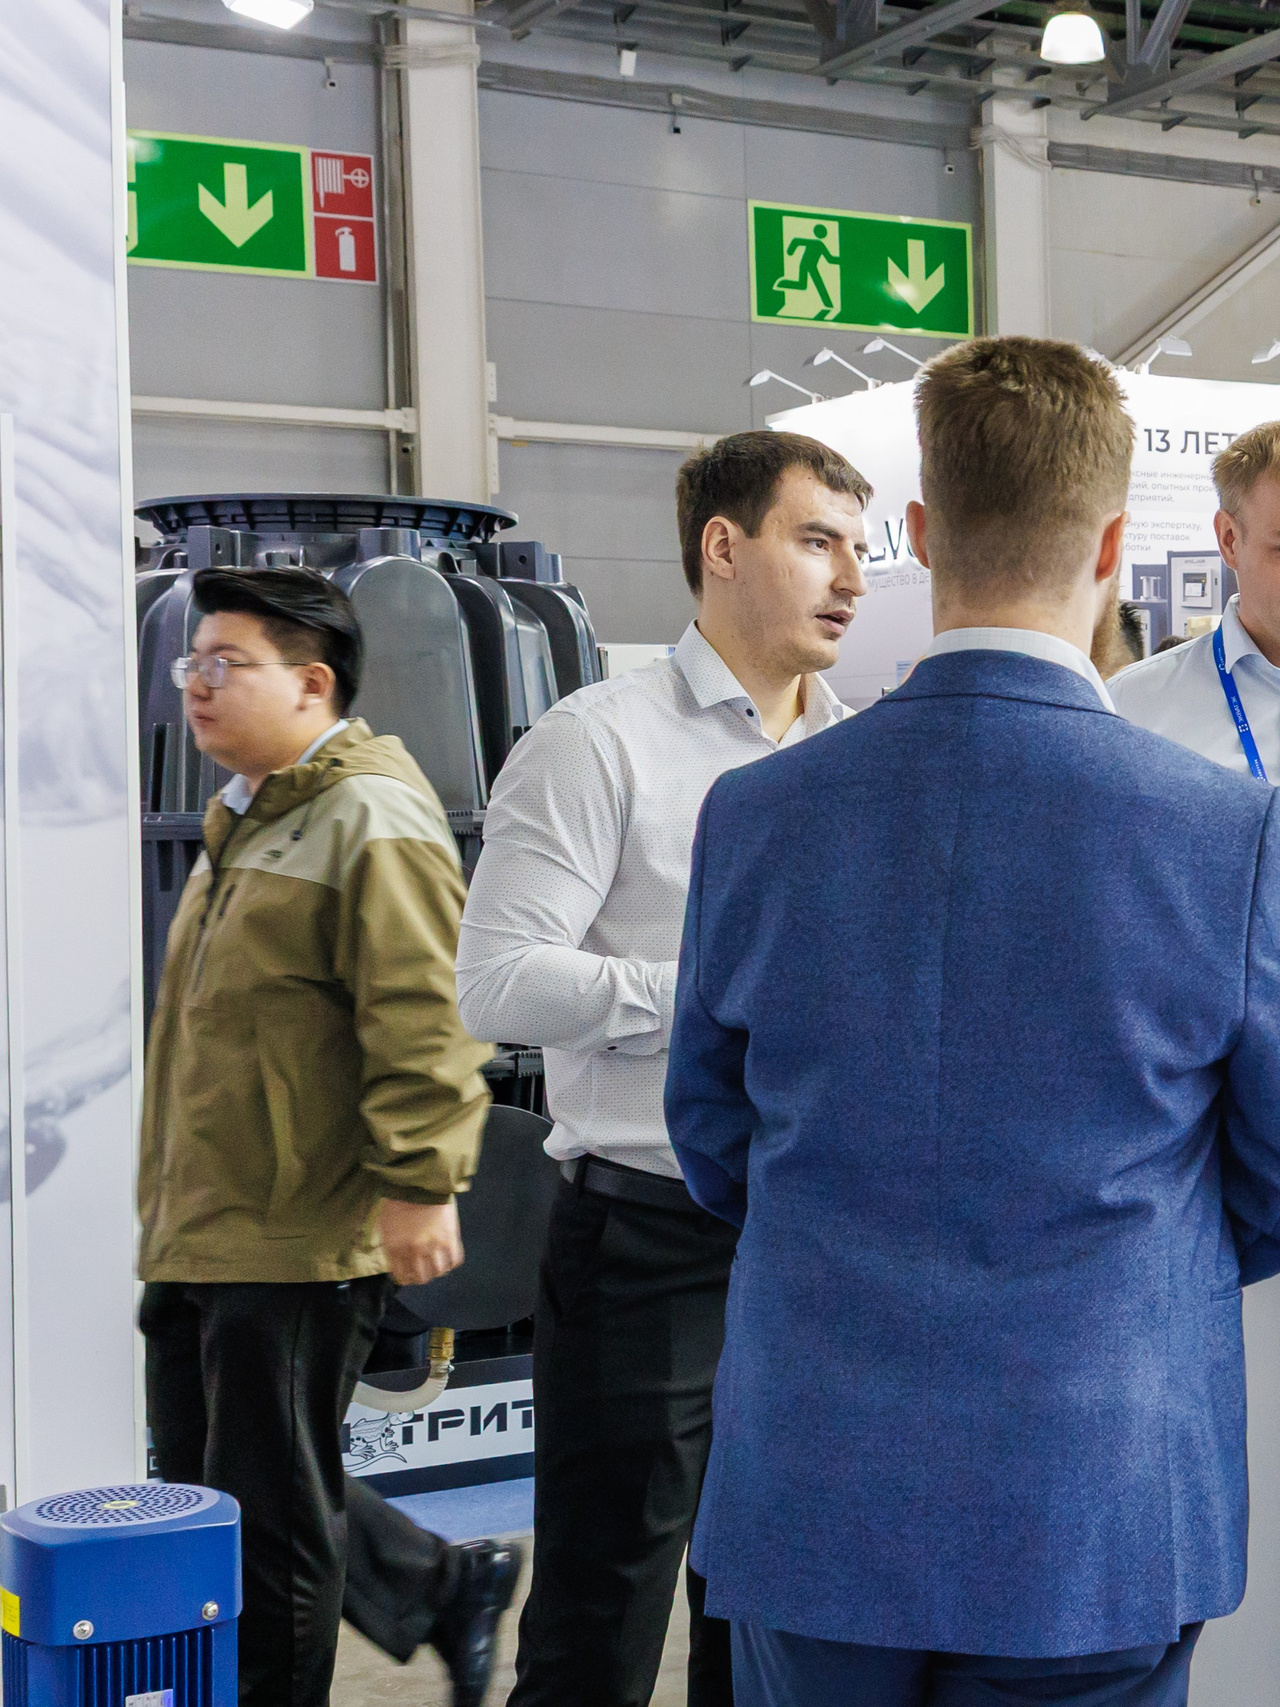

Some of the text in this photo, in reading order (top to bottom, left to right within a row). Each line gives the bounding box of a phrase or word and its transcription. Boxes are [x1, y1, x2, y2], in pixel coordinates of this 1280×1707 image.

[1144, 428, 1170, 453] 13
[1180, 430, 1238, 455] ЛЕТ
[1151, 483, 1190, 491] опытных
[1150, 533, 1191, 542] поставок
